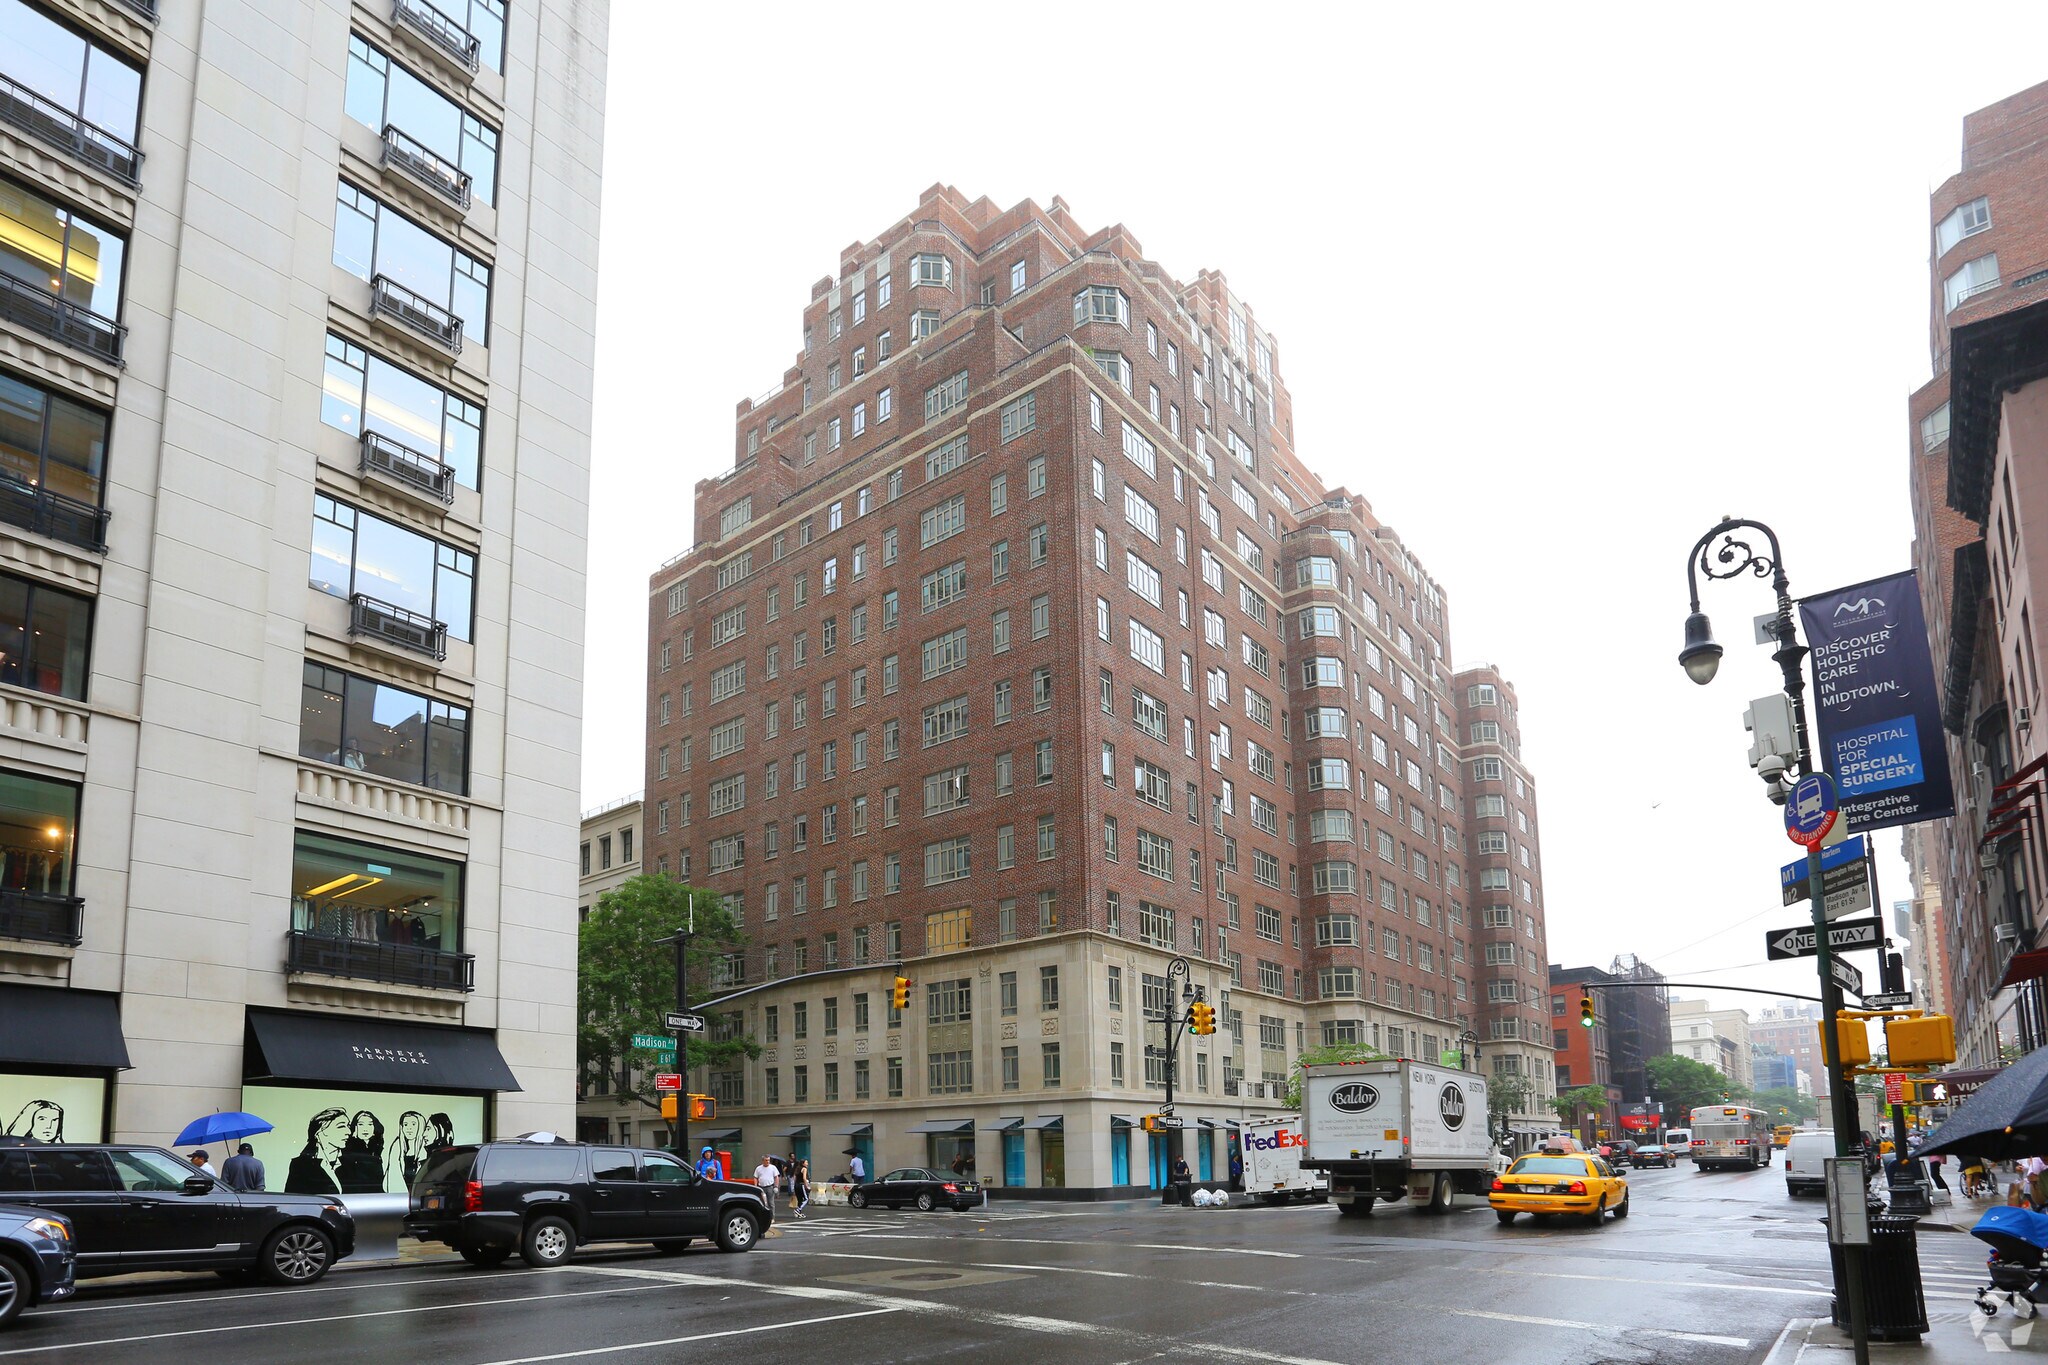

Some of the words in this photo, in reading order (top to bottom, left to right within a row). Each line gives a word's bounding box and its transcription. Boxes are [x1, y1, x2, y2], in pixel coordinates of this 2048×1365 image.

[1815, 630, 1890, 657] DISCOVER
[1817, 644, 1886, 669] HOLISTIC
[1818, 664, 1858, 681] CARE
[1820, 682, 1836, 694] IN
[1822, 680, 1900, 707] MIDTOWN.
[1837, 728, 1909, 752] HOSPITAL
[1838, 749, 1867, 764] FOR
[1840, 753, 1908, 775] SPECIAL
[1842, 763, 1916, 787] SURGERY
[1845, 813, 1871, 824] are
[1873, 804, 1919, 819] Center
[1790, 829, 1799, 840] NO
[1800, 814, 1832, 842] STANDING
[1821, 847, 1841, 859] Harlem
[1782, 866, 1796, 883] M1
[1784, 887, 1798, 905] M2
[1826, 891, 1849, 903] Madison
[1851, 888, 1858, 896] Av
[1827, 901, 1839, 911] East
[1841, 898, 1848, 907] 61
[1849, 897, 1856, 905] St
[1784, 934, 1815, 949] ONE
[1832, 928, 1867, 943] WAY
[1845, 972, 1858, 985] WAY
[635, 1037, 667, 1048] Madison
[352, 1046, 424, 1057] BARNEYS
[660, 1054, 664, 1063] E
[665, 1053, 671, 1063] 61
[1413, 1071, 1423, 1083] NEW
[1424, 1073, 1436, 1085] YORK
[1335, 1086, 1375, 1105] Baldor
[1468, 1081, 1485, 1093] BOSTON
[1442, 1089, 1463, 1117] Baldor
[1244, 1129, 1304, 1152] FedEx
